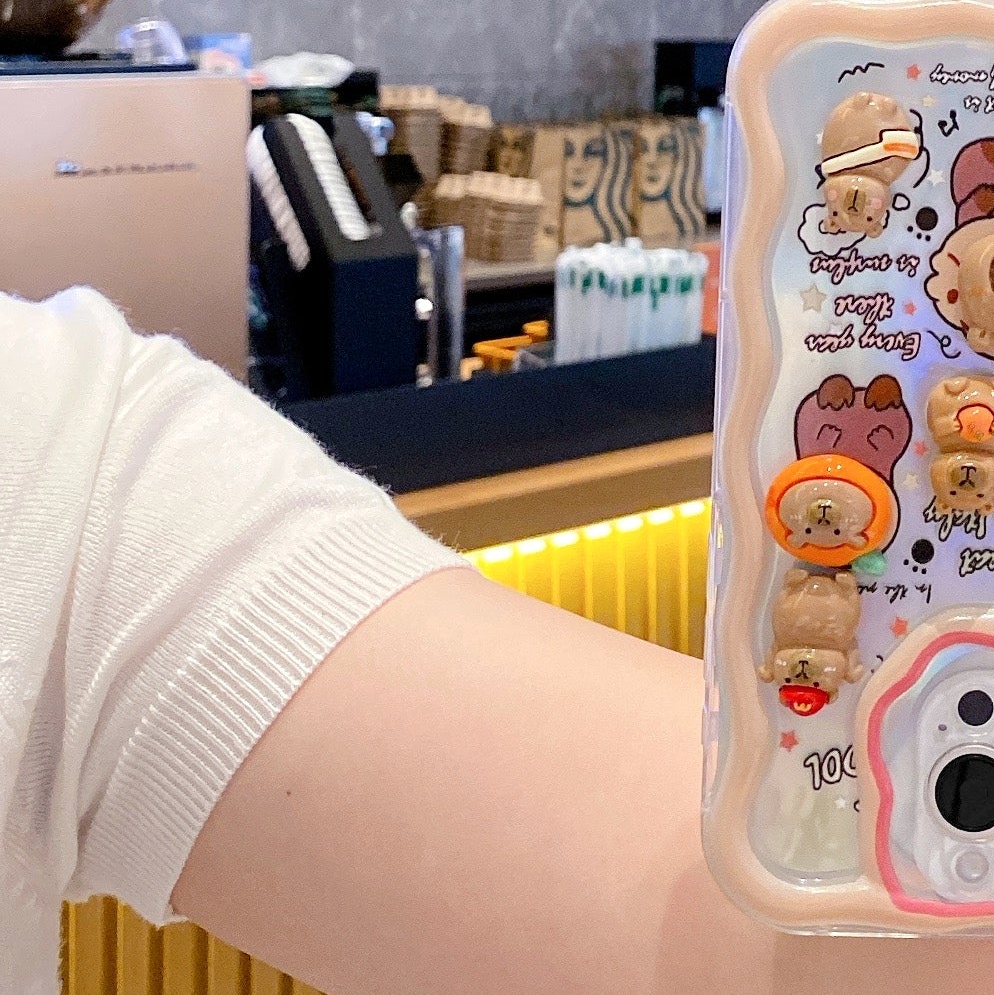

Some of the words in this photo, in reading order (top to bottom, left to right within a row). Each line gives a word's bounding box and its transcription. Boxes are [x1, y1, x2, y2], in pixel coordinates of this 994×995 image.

[930, 63, 988, 85] money
[964, 95, 981, 112] is
[810, 247, 893, 285] surplus
[896, 253, 920, 277] is
[834, 292, 895, 325] there
[804, 324, 855, 353] year
[859, 323, 921, 361] Every
[885, 583, 908, 604] the
